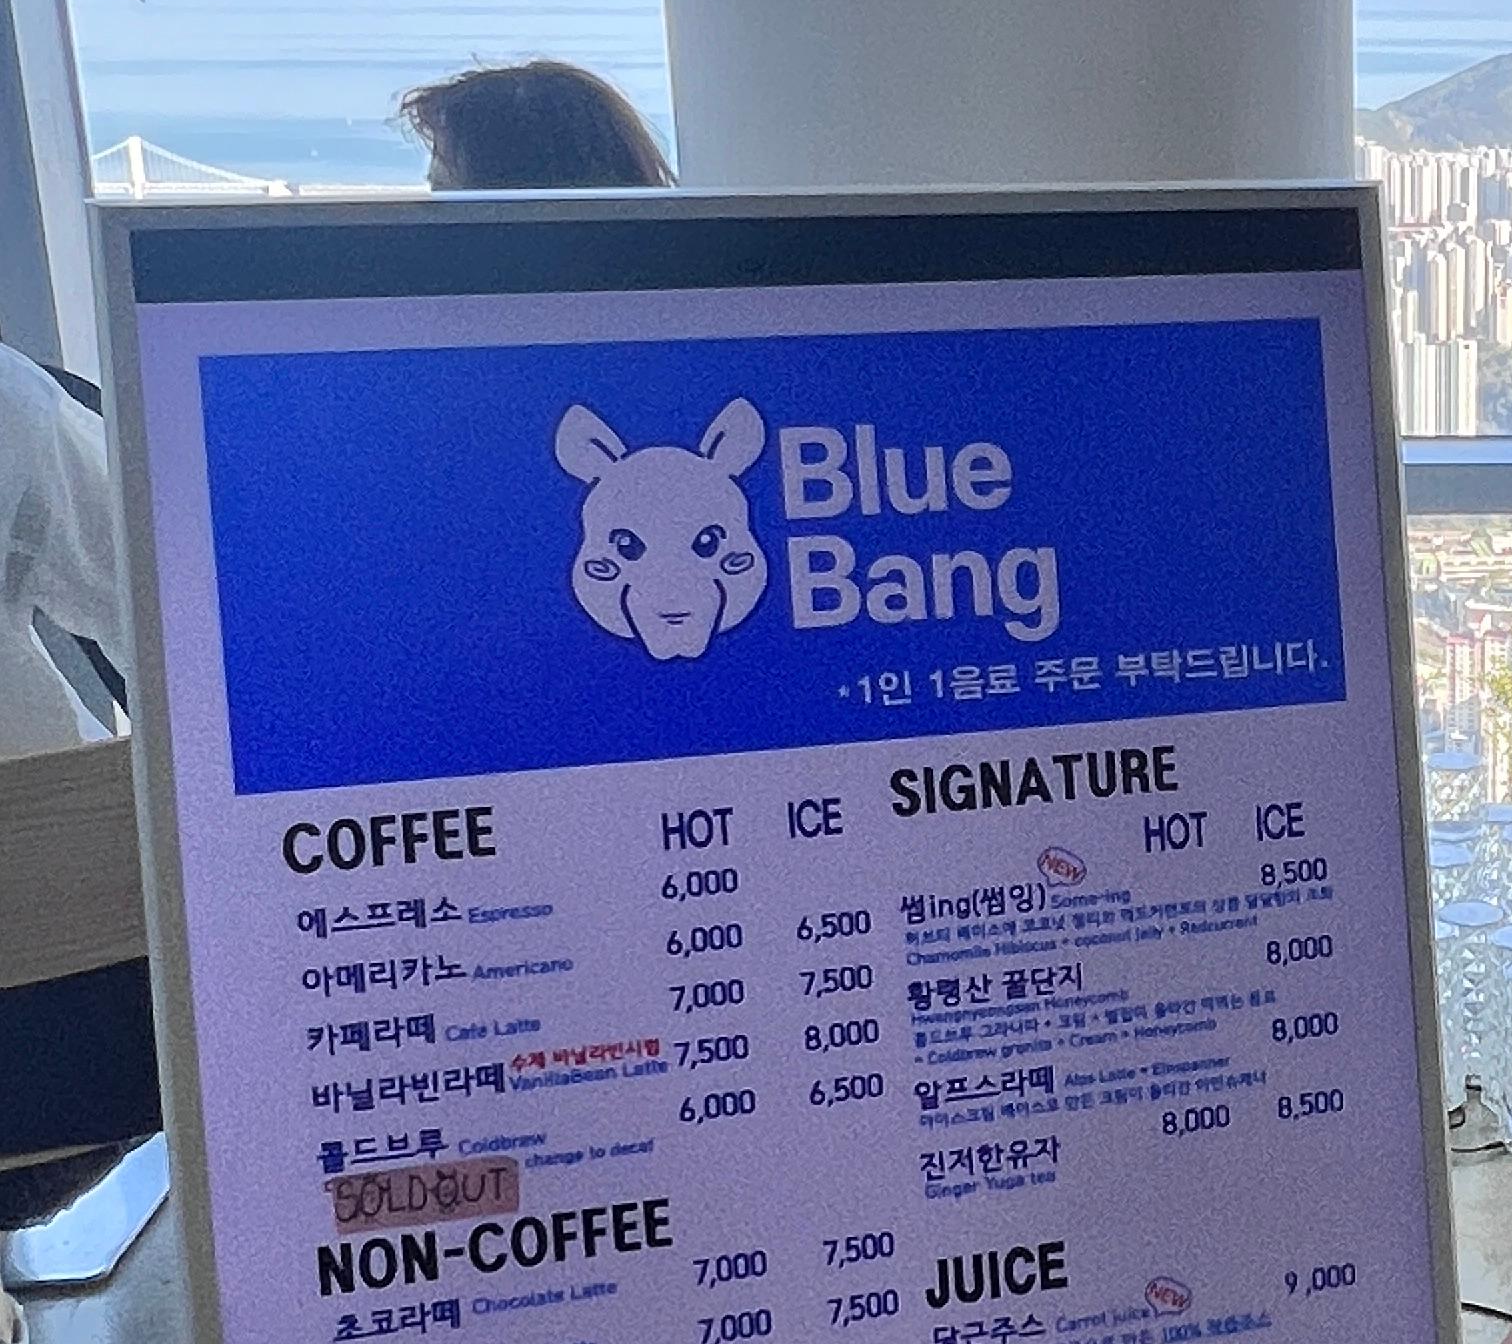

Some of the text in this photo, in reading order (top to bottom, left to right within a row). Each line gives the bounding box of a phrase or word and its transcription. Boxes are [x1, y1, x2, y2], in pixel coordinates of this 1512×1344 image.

[779, 424, 1013, 520] Blue
[786, 535, 1060, 641] Bang
[929, 665, 1020, 702] 1음료
[1033, 657, 1101, 693] 주문
[1116, 640, 1329, 685] 부탁드립니다.
[889, 745, 1179, 817] SIGNATURE
[282, 806, 496, 874] COFFEE
[661, 797, 843, 850] HOT ICE
[1143, 801, 1305, 853] HOT ICE
[661, 868, 738, 901] 6,000
[1260, 857, 1328, 889] 8,500
[298, 897, 553, 939] 에스프레소 Espresso
[900, 882, 1046, 924] 썸ing(썸잉)
[666, 923, 743, 958] 6,000
[797, 909, 871, 944] 6,500
[1266, 935, 1332, 966] 8,000
[302, 955, 574, 997] 아메리카노 Americano
[669, 964, 873, 1014] 7,000 7,500
[1001, 962, 1082, 1000] 꿀단지
[307, 1013, 435, 1055] 카페라떼
[673, 1018, 879, 1070] 7,500 8,000
[1272, 1011, 1338, 1043] 8,000
[311, 1062, 504, 1113] 바닐라빈라떼
[679, 1073, 884, 1124] 6,000 6,500
[914, 1065, 1054, 1111] 알프스라떼
[1162, 1088, 1344, 1139] 8,000 8,500
[317, 1128, 449, 1174] 콜드브루
[919, 1135, 1062, 1182] 진저한유자
[317, 1197, 673, 1297] NON-COFFEE
[693, 1231, 894, 1289] 7,000 7,500
[925, 1241, 1068, 1310] JUICE
[1150, 1281, 1186, 1308] NEW
[334, 1298, 460, 1343] 초코라떼
[472, 1288, 564, 1316] Chocolate
[826, 1289, 899, 1327] 7,500
